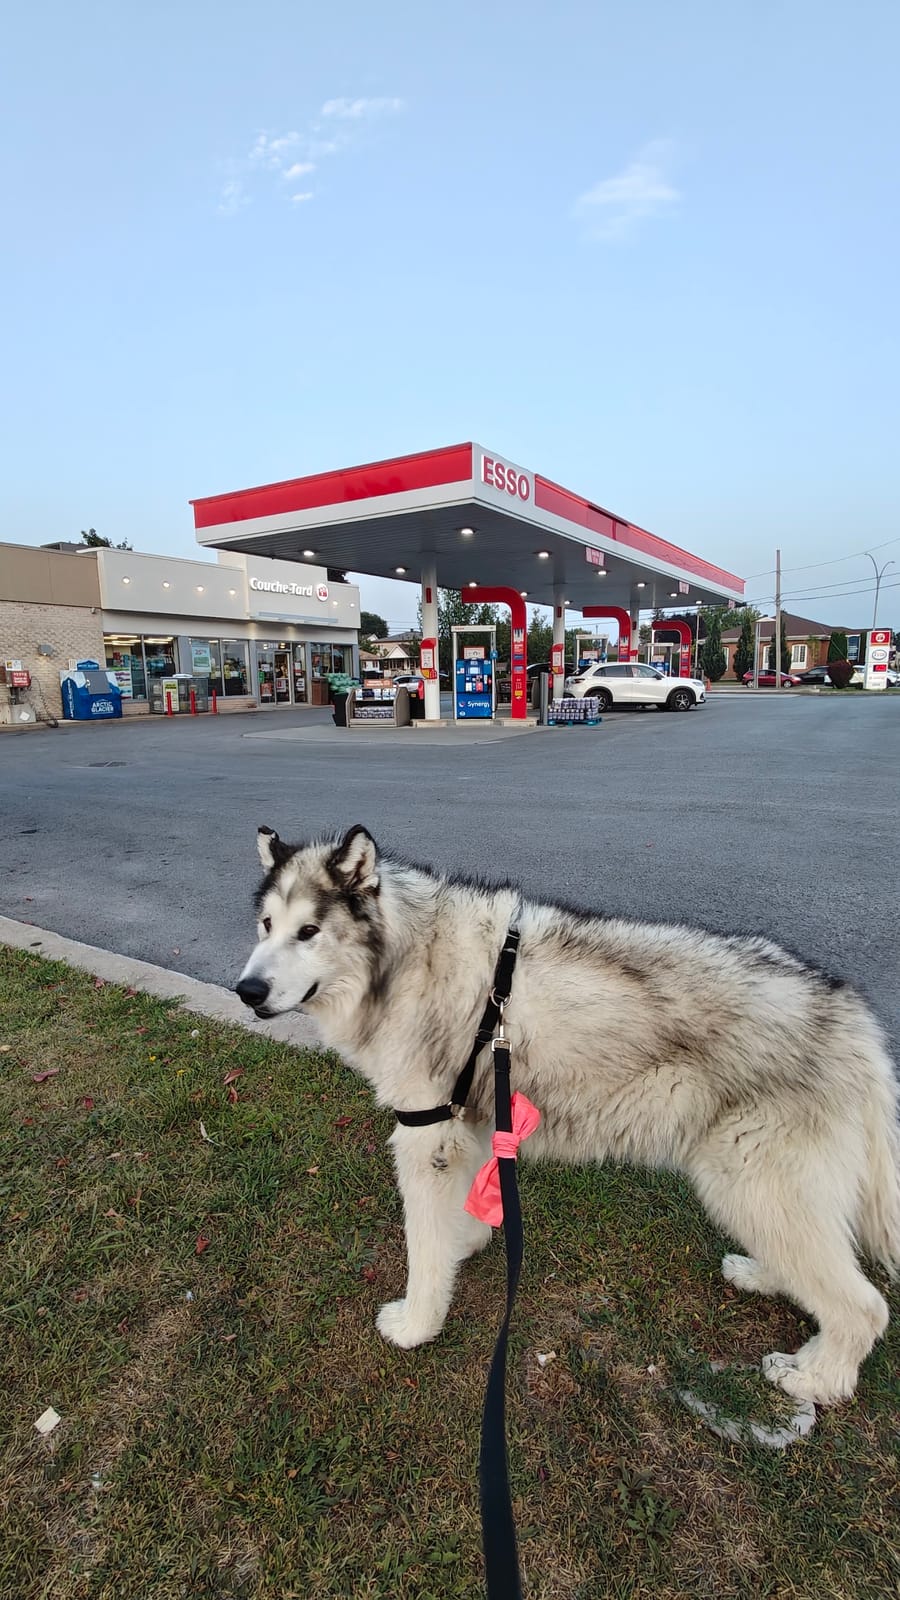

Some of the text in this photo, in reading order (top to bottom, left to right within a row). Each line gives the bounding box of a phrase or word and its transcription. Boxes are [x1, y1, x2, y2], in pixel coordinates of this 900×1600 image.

[481, 454, 530, 502] ESSO
[249, 577, 313, 597] Couche-Tard
[467, 700, 490, 708] Synergy
